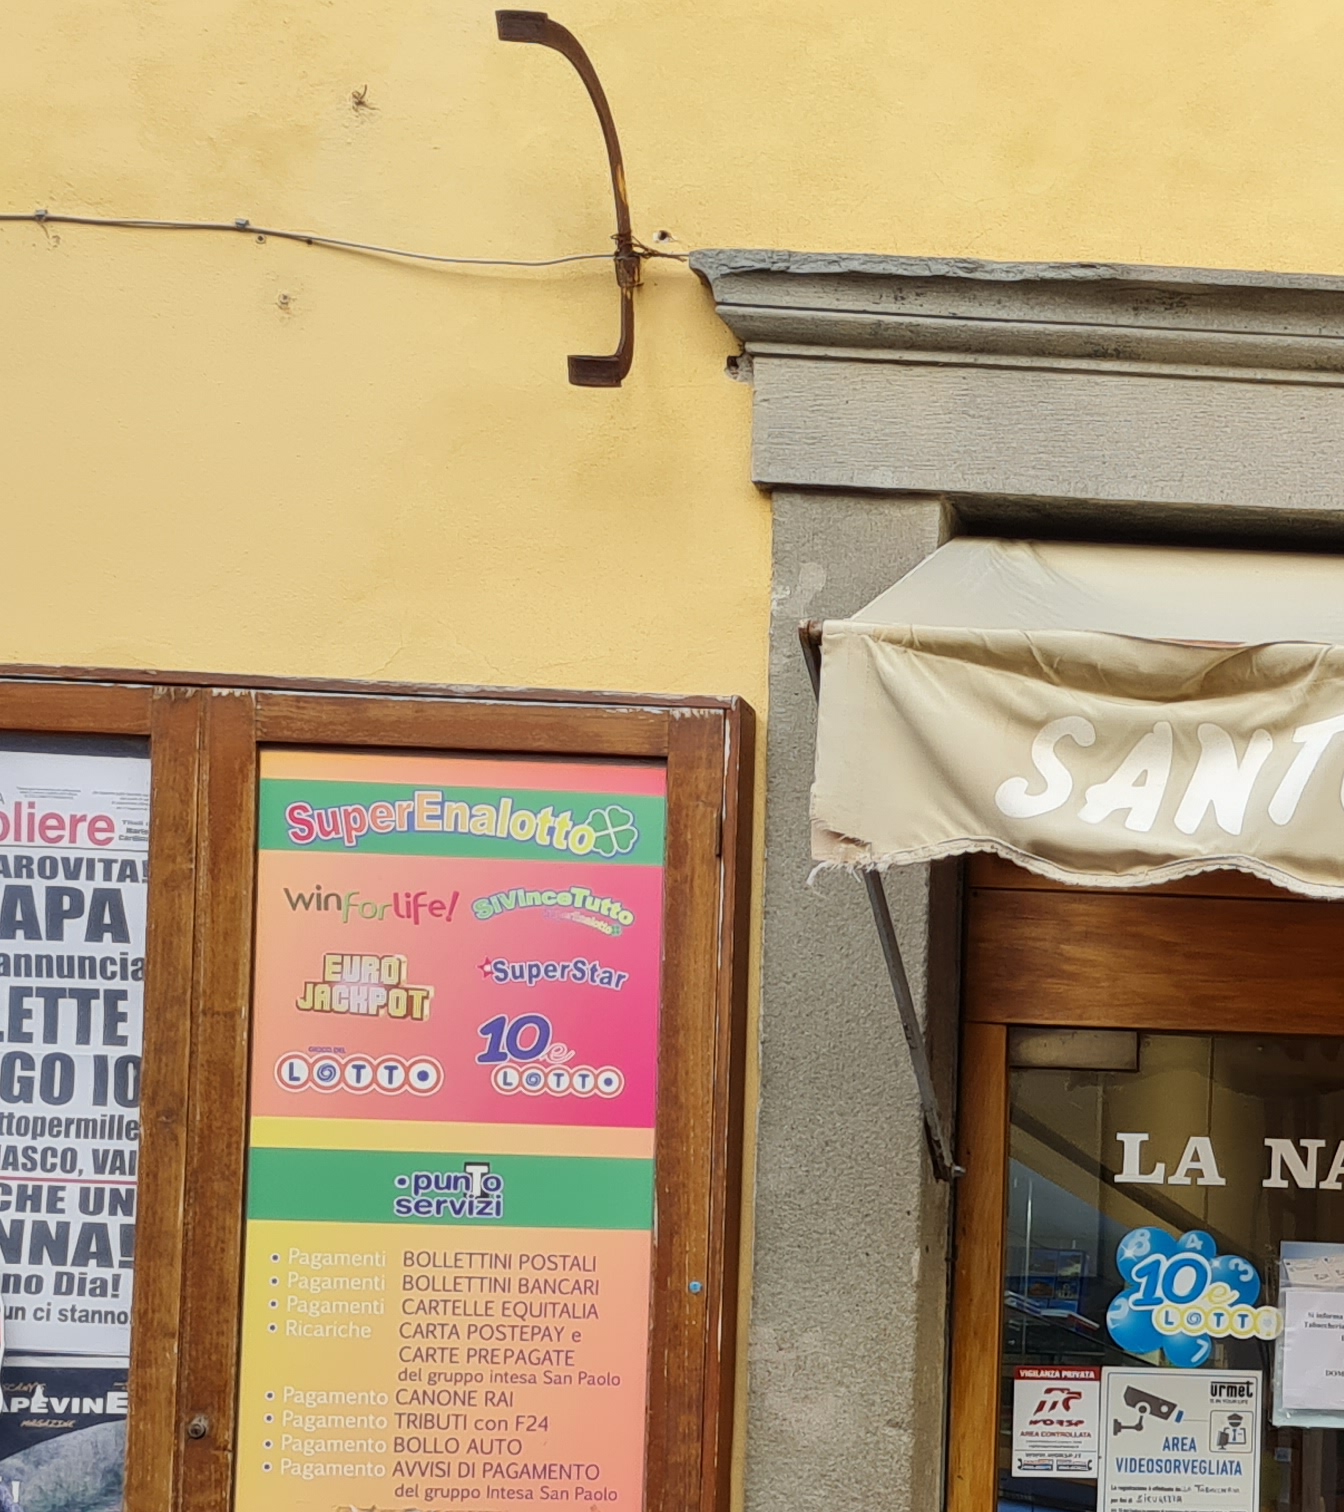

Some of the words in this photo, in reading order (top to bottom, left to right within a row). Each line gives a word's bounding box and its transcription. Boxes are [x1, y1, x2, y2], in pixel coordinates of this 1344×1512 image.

[286, 790, 596, 856] SuperEnalotto
[325, 953, 407, 986] EURO
[297, 984, 434, 1021] JACKPOT
[1113, 1131, 1226, 1188] LA
[394, 1195, 503, 1217] servizi
[287, 1247, 387, 1270] Pagamenti
[402, 1250, 513, 1271] BOLLETTINI
[518, 1253, 597, 1273] POSTALI
[284, 1319, 372, 1339] Ricariche
[398, 1322, 461, 1341] CARTA
[467, 1323, 565, 1343] POSTEPAY
[571, 1330, 582, 1343] e
[398, 1346, 460, 1365] CARTE
[466, 1347, 576, 1367] PREPAGATE
[1019, 1369, 1061, 1379] VIGILANZA
[1061, 1370, 1095, 1380] PRIVATA
[283, 1386, 389, 1408] Pagamento
[395, 1388, 478, 1407] CANONE
[484, 1389, 514, 1408] RAI
[1210, 1381, 1254, 1399] urmet
[281, 1409, 388, 1431] Pagamento
[394, 1411, 468, 1431] TRIBUTI
[474, 1418, 509, 1432] con
[515, 1415, 549, 1432] F24
[280, 1434, 387, 1457] Pagamento
[393, 1436, 460, 1455] BOLLO
[466, 1437, 523, 1455] AUTO
[1162, 1436, 1197, 1452] AREA
[279, 1458, 386, 1480] Pagamento
[391, 1460, 451, 1479] AVVISI
[457, 1461, 475, 1479] DI
[482, 1461, 601, 1481] PAGAMENTO
[1115, 1457, 1243, 1477] VIDEOSORVEGLIATA
